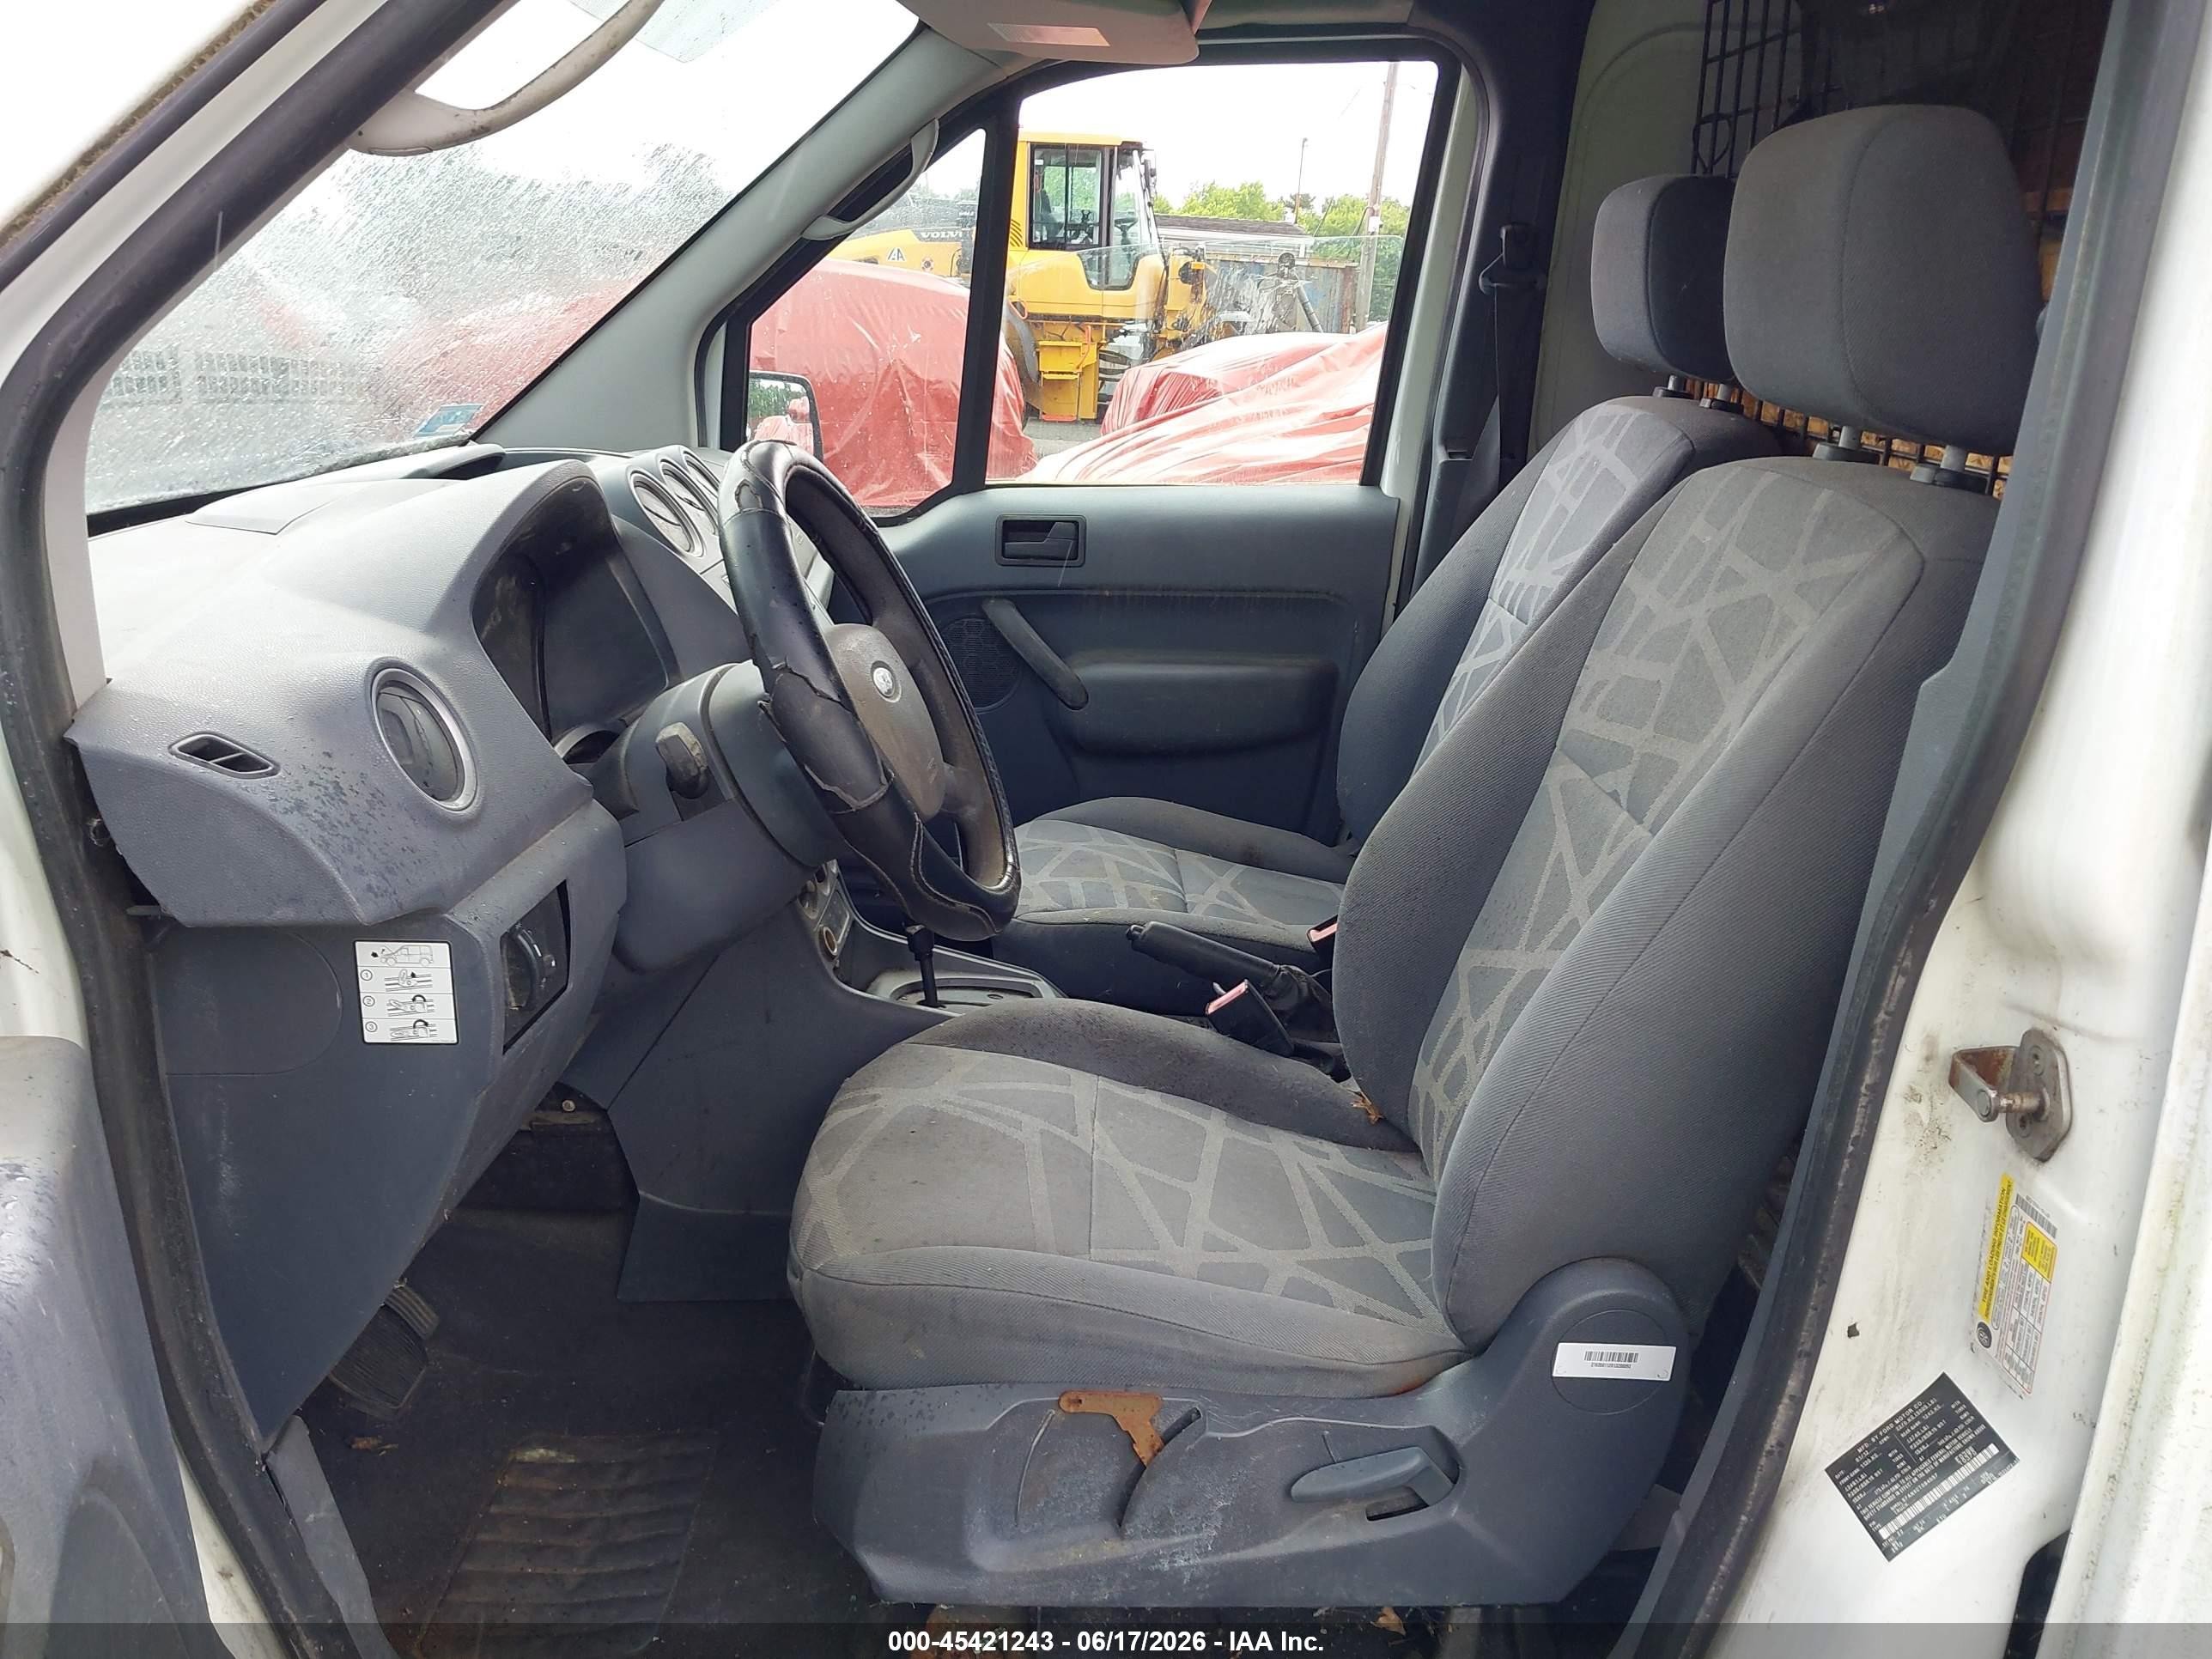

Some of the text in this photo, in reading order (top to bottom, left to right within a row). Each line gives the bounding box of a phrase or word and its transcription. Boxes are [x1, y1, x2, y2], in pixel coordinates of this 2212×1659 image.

[1989, 1237, 1997, 1270] LOADING
[1994, 1187, 2006, 1237] INFORMATION
[1878, 1422, 1894, 1437] FORD
[1893, 1407, 1914, 1425] MOTOR
